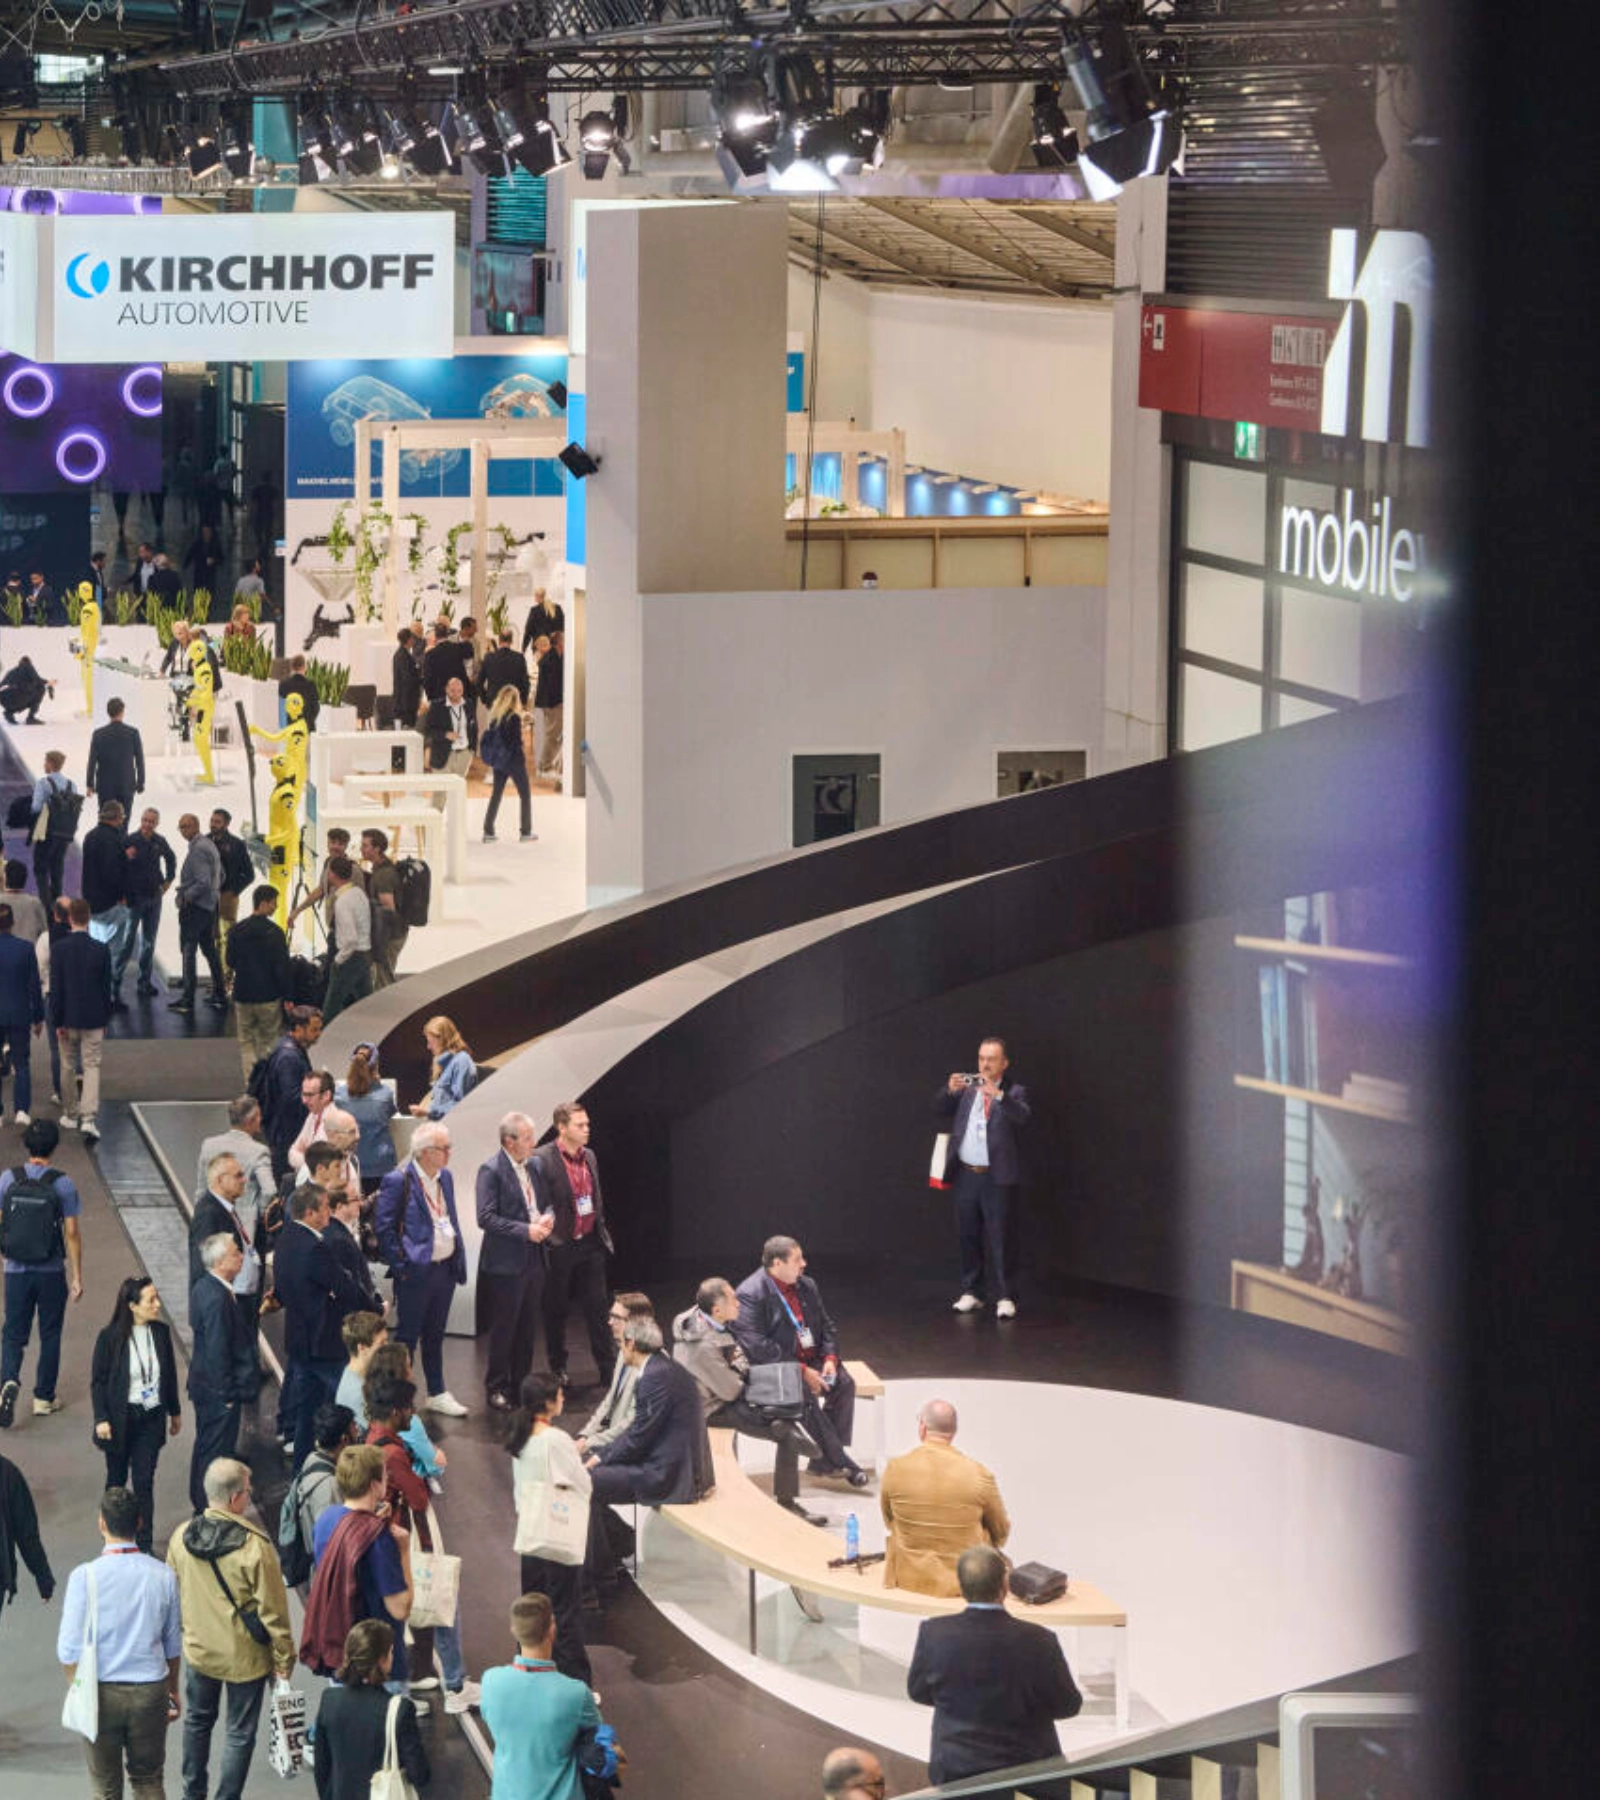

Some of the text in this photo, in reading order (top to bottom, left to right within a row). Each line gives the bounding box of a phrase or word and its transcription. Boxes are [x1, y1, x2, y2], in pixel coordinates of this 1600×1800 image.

[120, 254, 434, 292] KIRCHHOFF
[117, 301, 309, 325] AUTOMOTIVE
[1279, 488, 1424, 604] mobile
